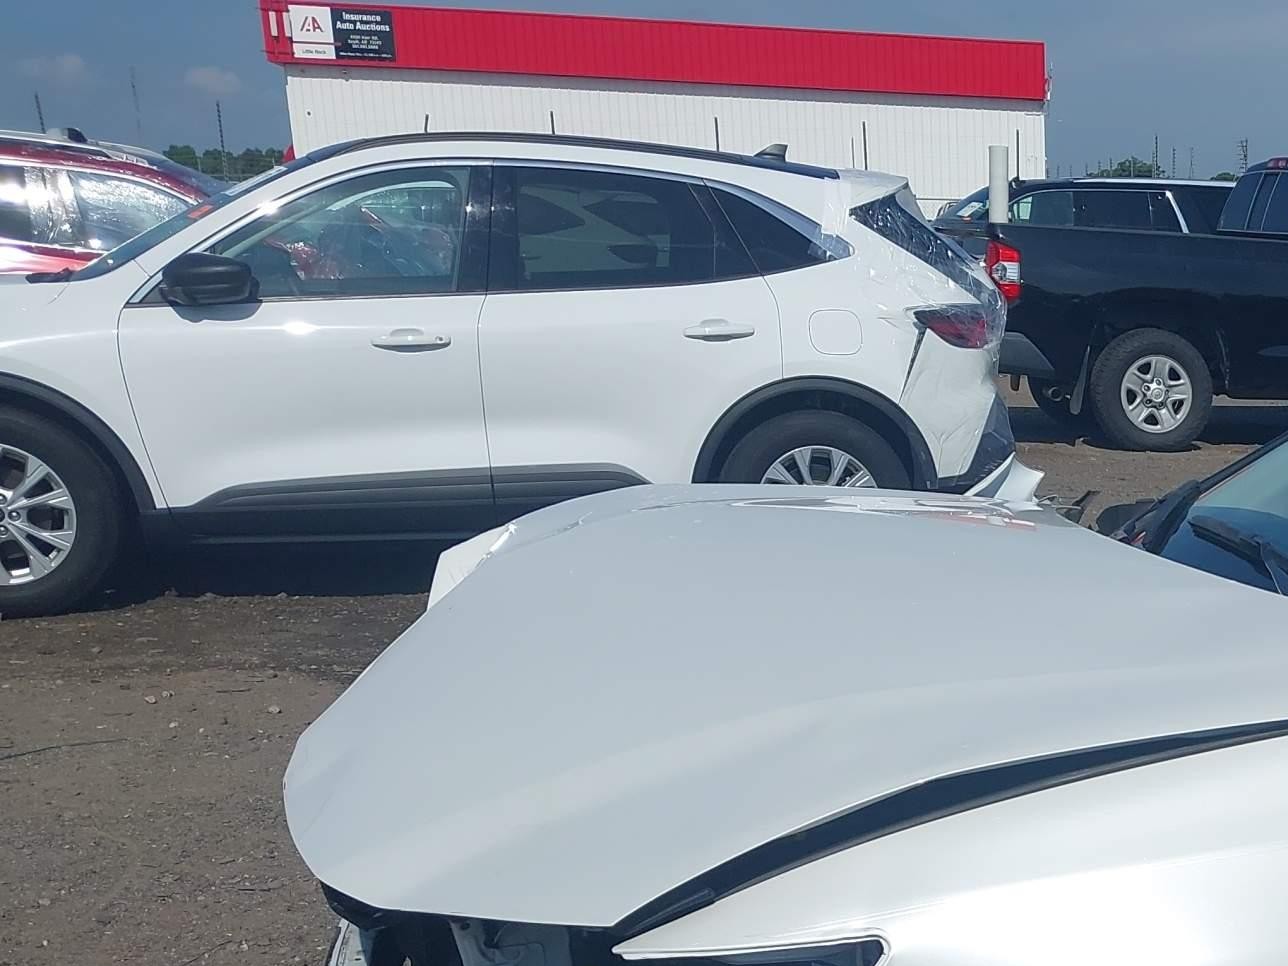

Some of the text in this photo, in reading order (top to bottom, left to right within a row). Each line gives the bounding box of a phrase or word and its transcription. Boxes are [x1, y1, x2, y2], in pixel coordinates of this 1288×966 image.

[342, 11, 381, 21] Insurance
[336, 20, 390, 32] Auto Auctions
